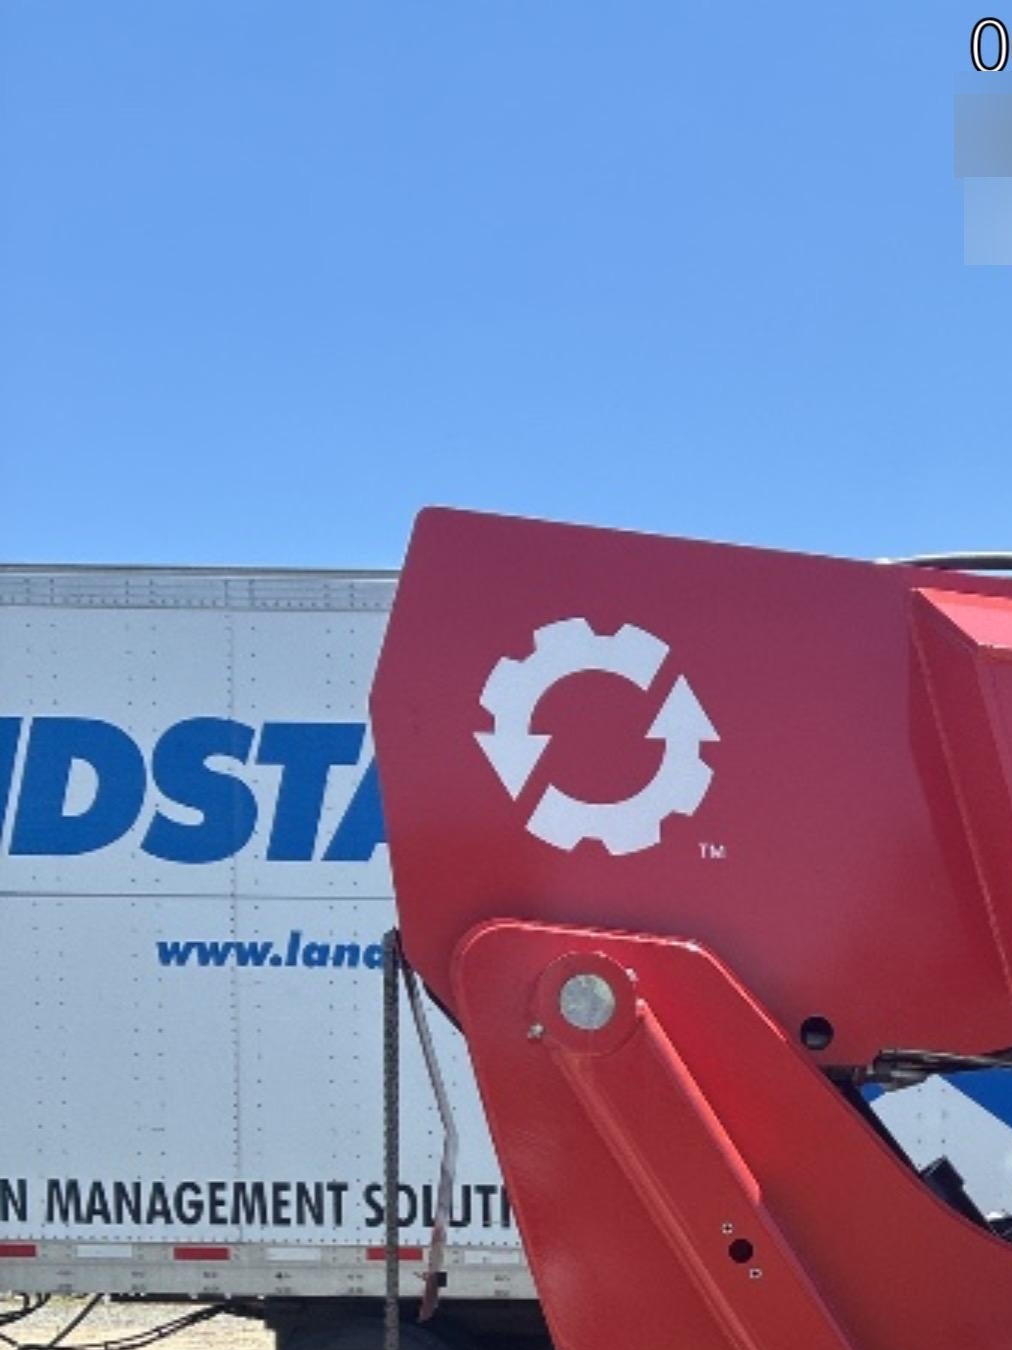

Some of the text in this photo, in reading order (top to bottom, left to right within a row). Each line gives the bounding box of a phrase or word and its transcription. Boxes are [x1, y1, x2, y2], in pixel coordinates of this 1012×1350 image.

[0, 716, 390, 864] DST
[698, 842, 727, 859] TM
[47, 1178, 348, 1227] MANAGEMENT
